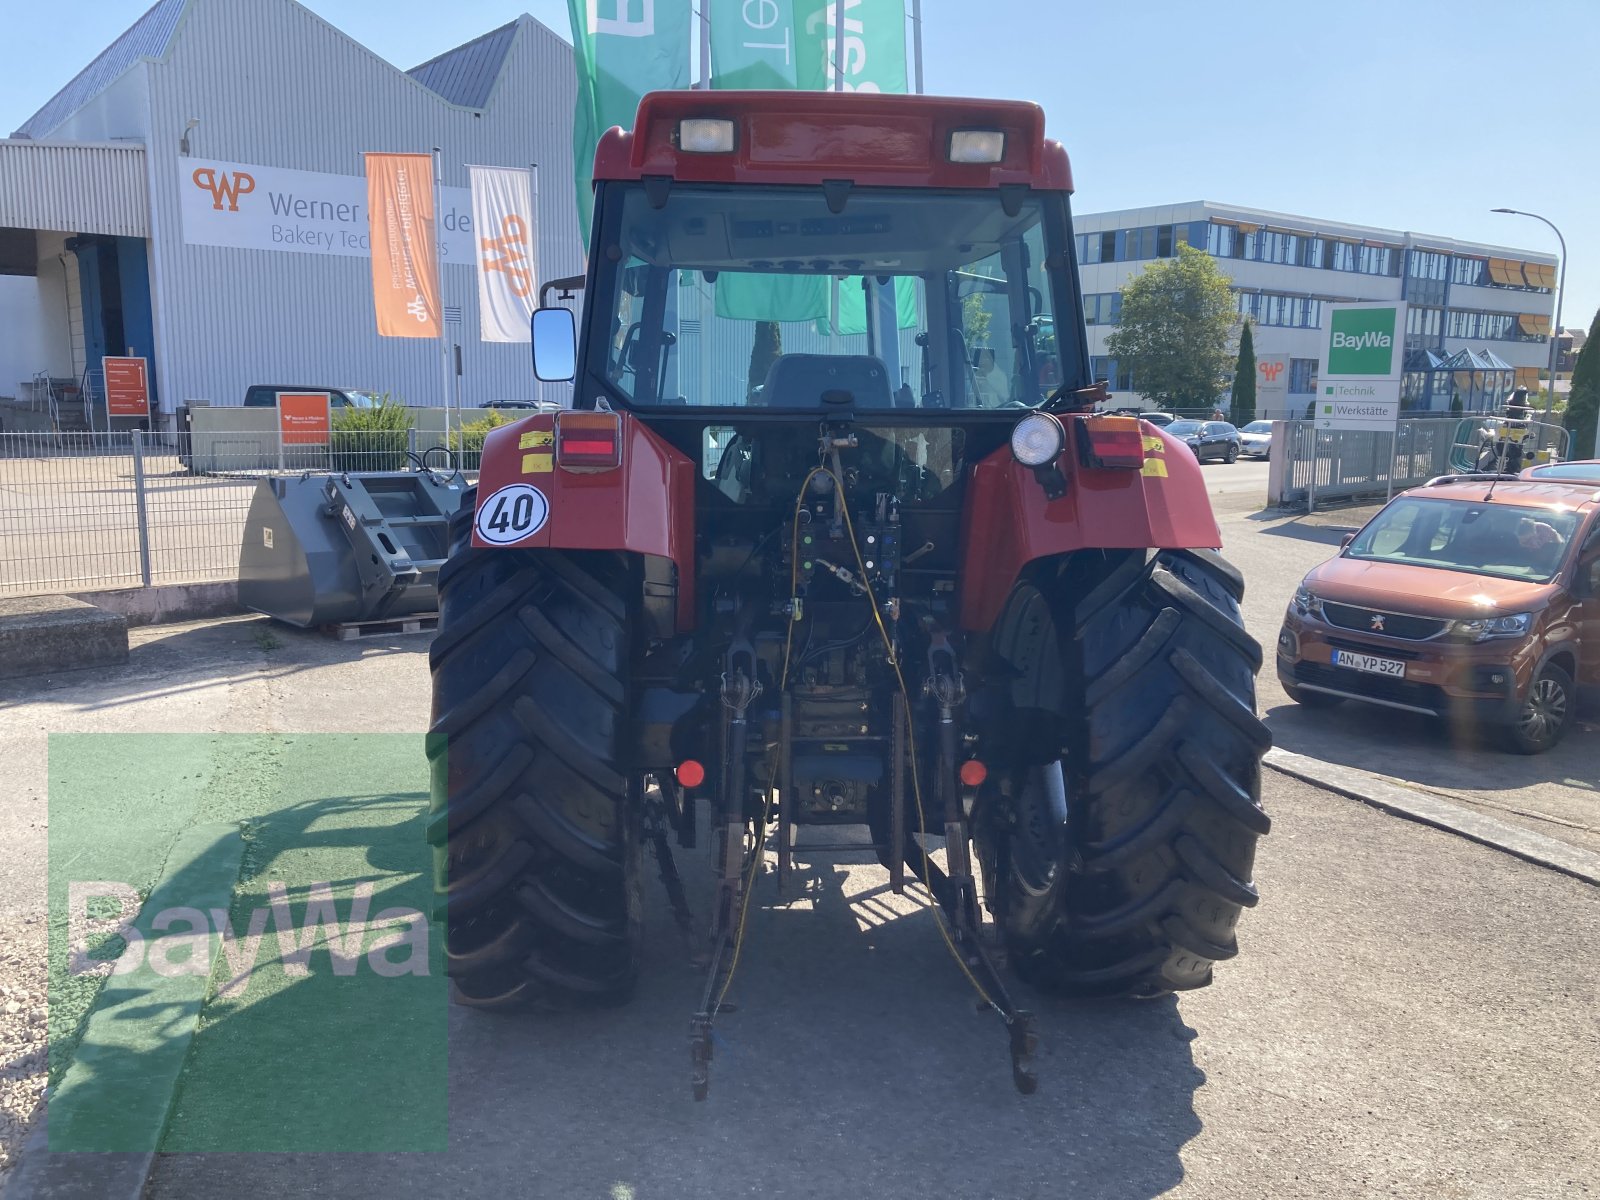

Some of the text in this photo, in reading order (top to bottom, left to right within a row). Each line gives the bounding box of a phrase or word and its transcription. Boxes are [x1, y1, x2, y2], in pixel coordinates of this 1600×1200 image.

[268, 191, 360, 223] Werner
[271, 224, 334, 251] Bakery
[1332, 331, 1391, 351] BayWa
[1339, 385, 1376, 396] Technik
[1336, 405, 1389, 416] Werkstätte
[488, 493, 534, 533] 40
[1338, 652, 1355, 666] AN
[1362, 656, 1378, 670] YP
[1379, 660, 1404, 675] 527
